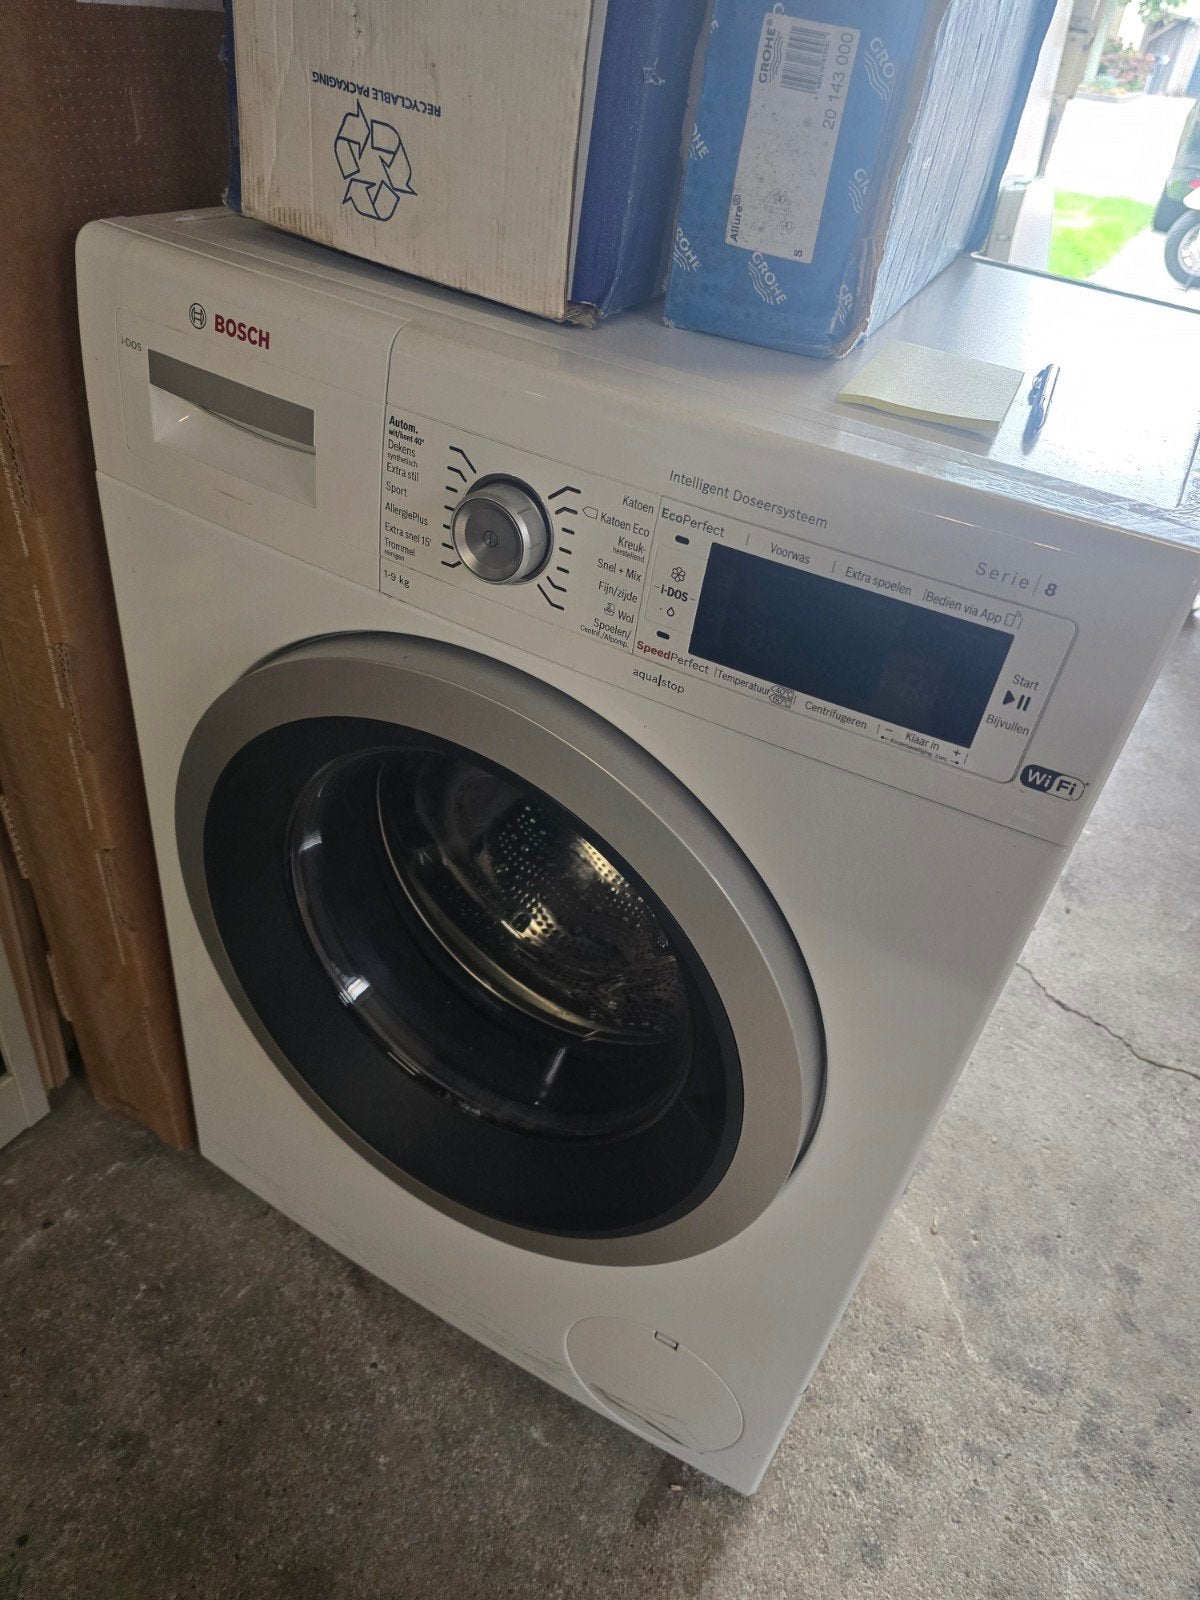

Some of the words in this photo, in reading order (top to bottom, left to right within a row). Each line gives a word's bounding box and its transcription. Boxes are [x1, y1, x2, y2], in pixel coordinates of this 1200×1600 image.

[836, 32, 854, 66] 000
[312, 71, 370, 98] PACKAGING
[829, 71, 845, 102] 143
[372, 87, 442, 118] RECYCLABLE
[822, 108, 837, 131] 20
[752, 251, 788, 305] GROHE
[214, 313, 271, 351] BOSCH
[389, 415, 419, 435] Autom.
[388, 438, 416, 458] Dekens
[386, 462, 406, 478] Extra
[407, 471, 419, 482] stil
[385, 481, 408, 498] Sport
[669, 469, 730, 499] Intelligent
[733, 489, 828, 529] Doseersysteem
[384, 502, 429, 526] AllergiePlus
[622, 494, 654, 514] Katoen
[384, 522, 404, 538] Extra
[405, 530, 420, 544] snel
[600, 512, 631, 531] Katoen
[632, 523, 650, 537] Eco
[661, 507, 726, 538] EcoPerfect
[384, 536, 416, 557] Trommel
[617, 535, 646, 553] Kreuk-
[770, 541, 811, 565] Voorwas
[383, 569, 397, 582] 1-9
[399, 575, 410, 589] kg
[597, 558, 617, 573] Snel
[625, 568, 642, 582] Mix
[845, 565, 871, 585] Extra
[872, 575, 912, 597] spoelen
[975, 561, 1030, 590] Serie
[1044, 582, 1058, 598] 8
[598, 580, 638, 603] Fijn/zijde
[618, 609, 635, 624] Wol
[926, 591, 962, 612] Bedien
[963, 601, 979, 618] via
[979, 608, 1003, 626] App
[593, 617, 632, 640] Spoelen/
[636, 640, 710, 675] SpeedPerfect
[717, 669, 771, 696] Temperatuur
[1012, 674, 1040, 692] Start
[804, 700, 867, 730] Centrifugeren
[985, 713, 1030, 737] Bijvullen
[905, 732, 929, 748] Klaar
[930, 741, 940, 751] in
